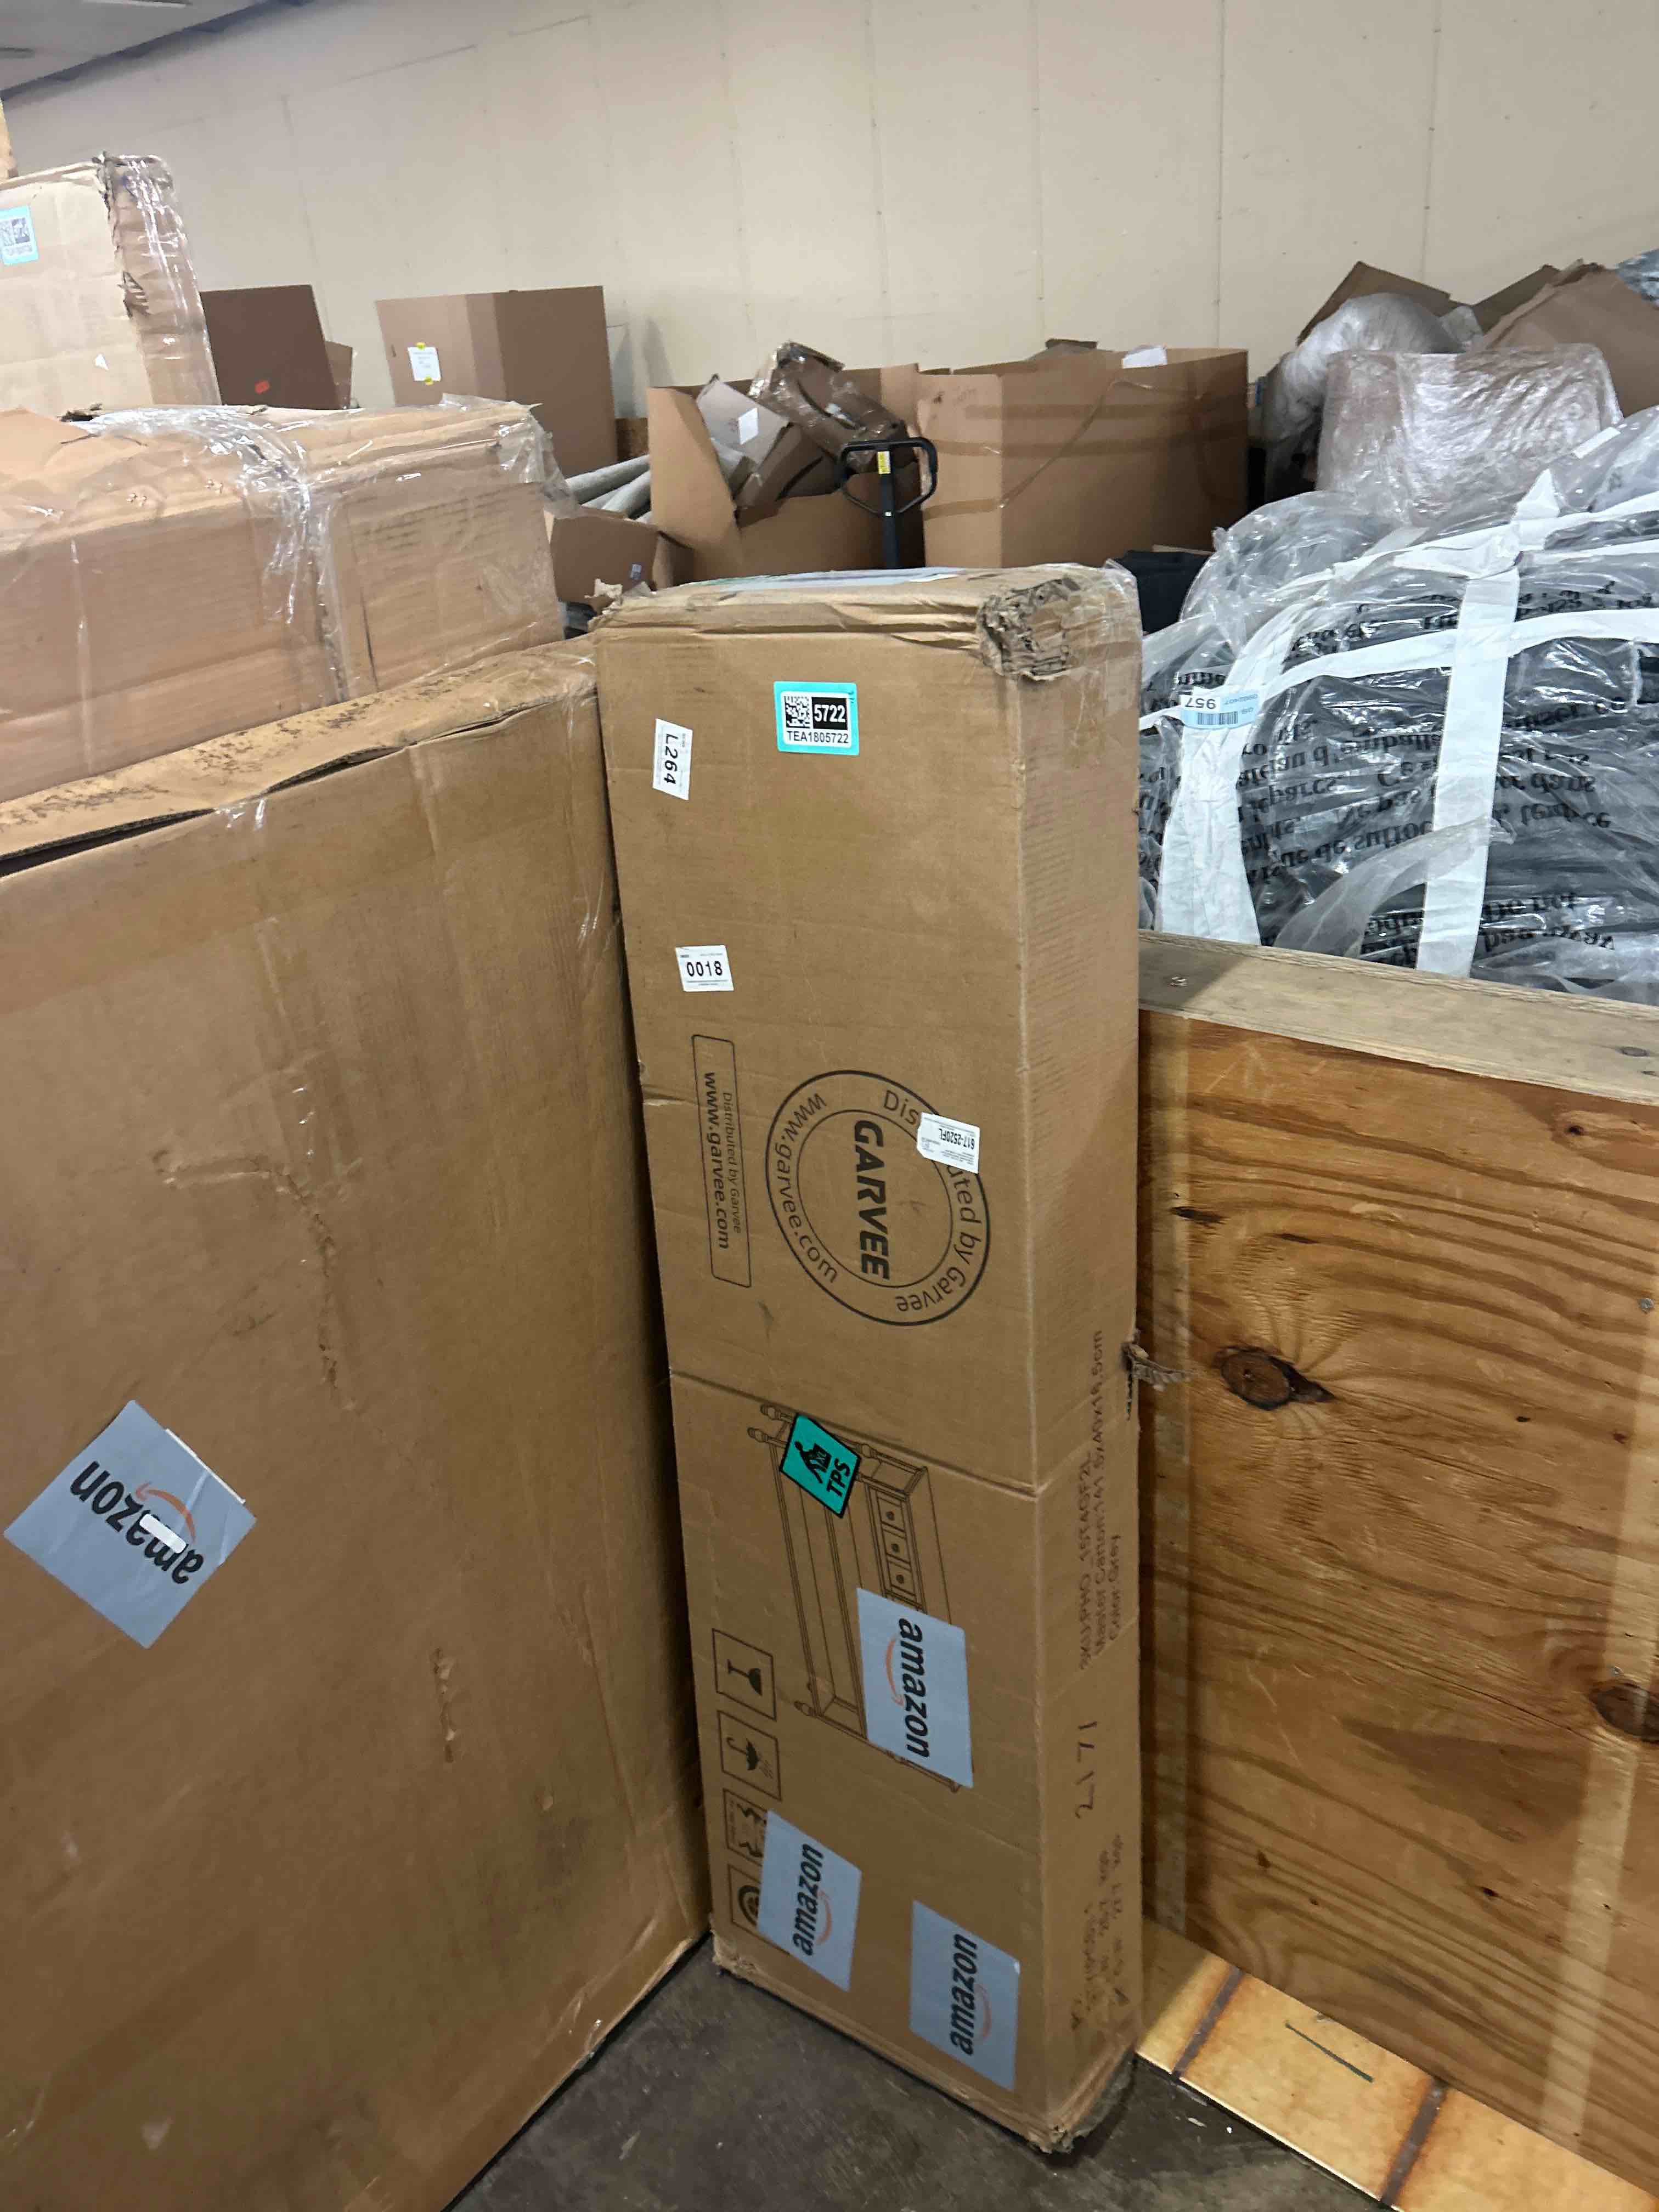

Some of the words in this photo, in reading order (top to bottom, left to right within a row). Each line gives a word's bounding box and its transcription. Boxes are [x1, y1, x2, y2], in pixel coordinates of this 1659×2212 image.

[813, 703, 846, 723] 5722
[1185, 697, 1216, 710] 957
[664, 733, 679, 785] L264
[786, 730, 849, 744] TEA1805722
[687, 961, 723, 977] 0018
[723, 1092, 738, 1165] Distributed
[704, 1072, 729, 1249] www.garvee.com
[727, 1168, 740, 1184] by
[883, 1090, 976, 1228] Disuted
[730, 1188, 743, 1234] Garvee
[774, 1092, 839, 1283] www.garvee.com
[854, 1119, 890, 1280] GARVEE
[953, 1231, 982, 1265] by
[895, 1266, 967, 1312] Garvee
[826, 1457, 850, 1498] TPS
[70, 1460, 204, 1585] amazon
[899, 1617, 930, 1758] amazon
[792, 1843, 823, 1956] amazon
[949, 1933, 978, 2056] amazon
